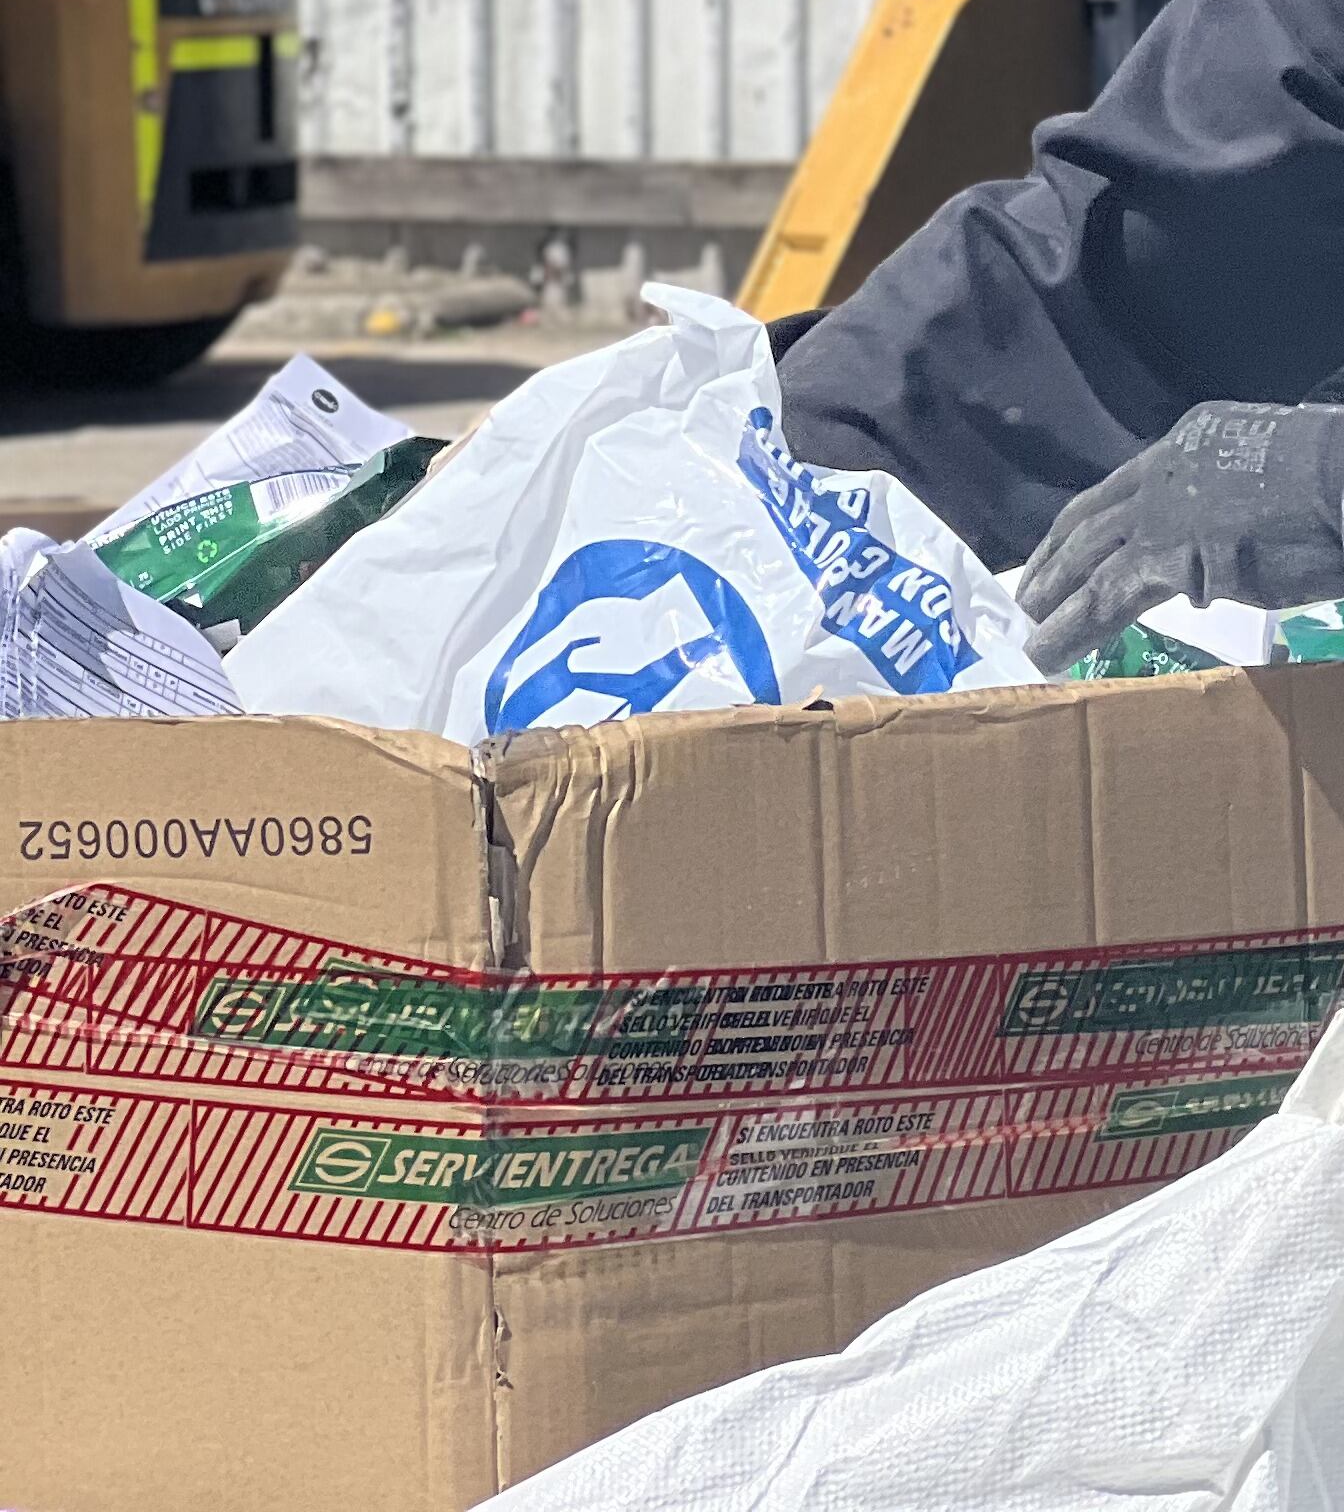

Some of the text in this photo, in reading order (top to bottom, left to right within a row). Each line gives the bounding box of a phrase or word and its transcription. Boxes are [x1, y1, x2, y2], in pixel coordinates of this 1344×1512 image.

[154, 513, 182, 535] LADO
[158, 516, 196, 546] PRINT
[163, 531, 192, 555] SIDE
[19, 815, 372, 861] 5860AA000652
[88, 900, 129, 922] ESTE
[891, 976, 929, 995] ESTE
[608, 1039, 703, 1059] CONTENIDO
[828, 1028, 915, 1049] PRESENCIA
[28, 1100, 72, 1119] ROTO
[73, 1106, 116, 1125] ESTE
[32, 1126, 51, 1143] EL
[736, 1112, 936, 1144] SI ENCUENTRA ROTO ESTE
[6, 1149, 97, 1173] PRESENCIA
[716, 1149, 921, 1188] CONTENIDO EN PRESENCIA
[729, 1150, 777, 1166] SELLO
[706, 1180, 876, 1215] DEL TRANSPORTADOR
[449, 1193, 677, 1230] Centro de Soluciones
